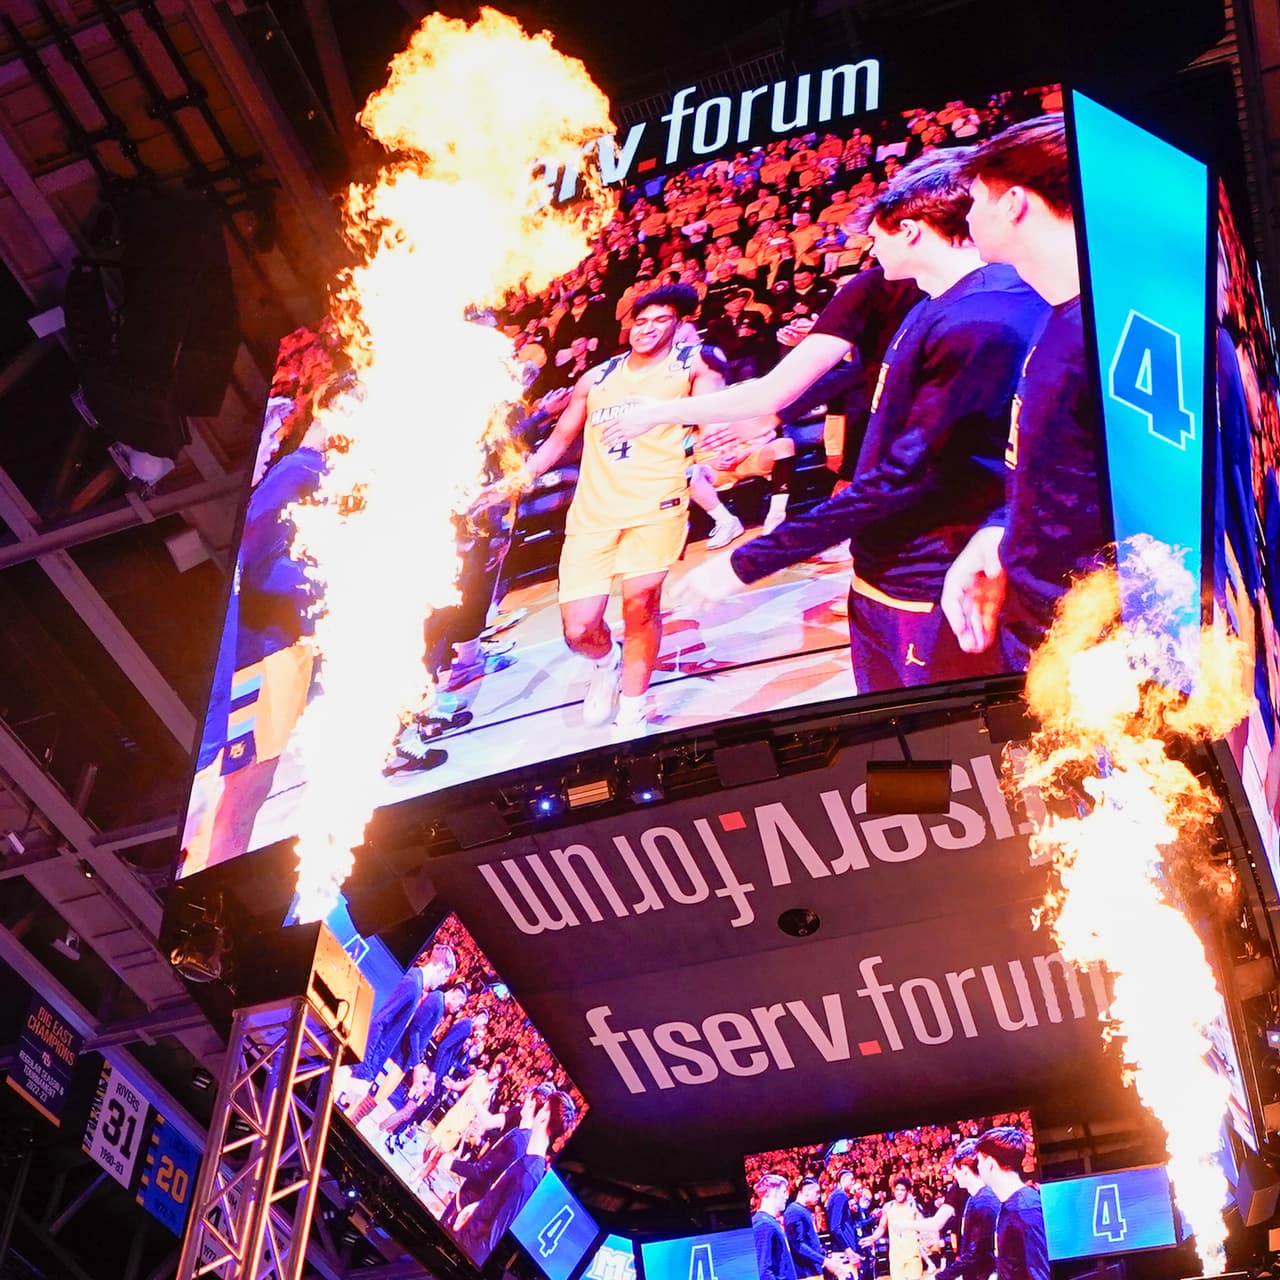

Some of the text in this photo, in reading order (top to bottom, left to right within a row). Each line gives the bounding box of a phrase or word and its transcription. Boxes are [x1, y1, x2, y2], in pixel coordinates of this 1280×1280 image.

[1108, 308, 1196, 452] 4
[27, 1013, 76, 1067] CHAMPIONS
[38, 1006, 75, 1044] BIG EAST
[115, 1082, 140, 1114] RIVERS
[103, 1098, 137, 1160] 31
[155, 1154, 188, 1206] 20
[537, 1204, 575, 1258] 4
[1093, 1183, 1127, 1242] 4
